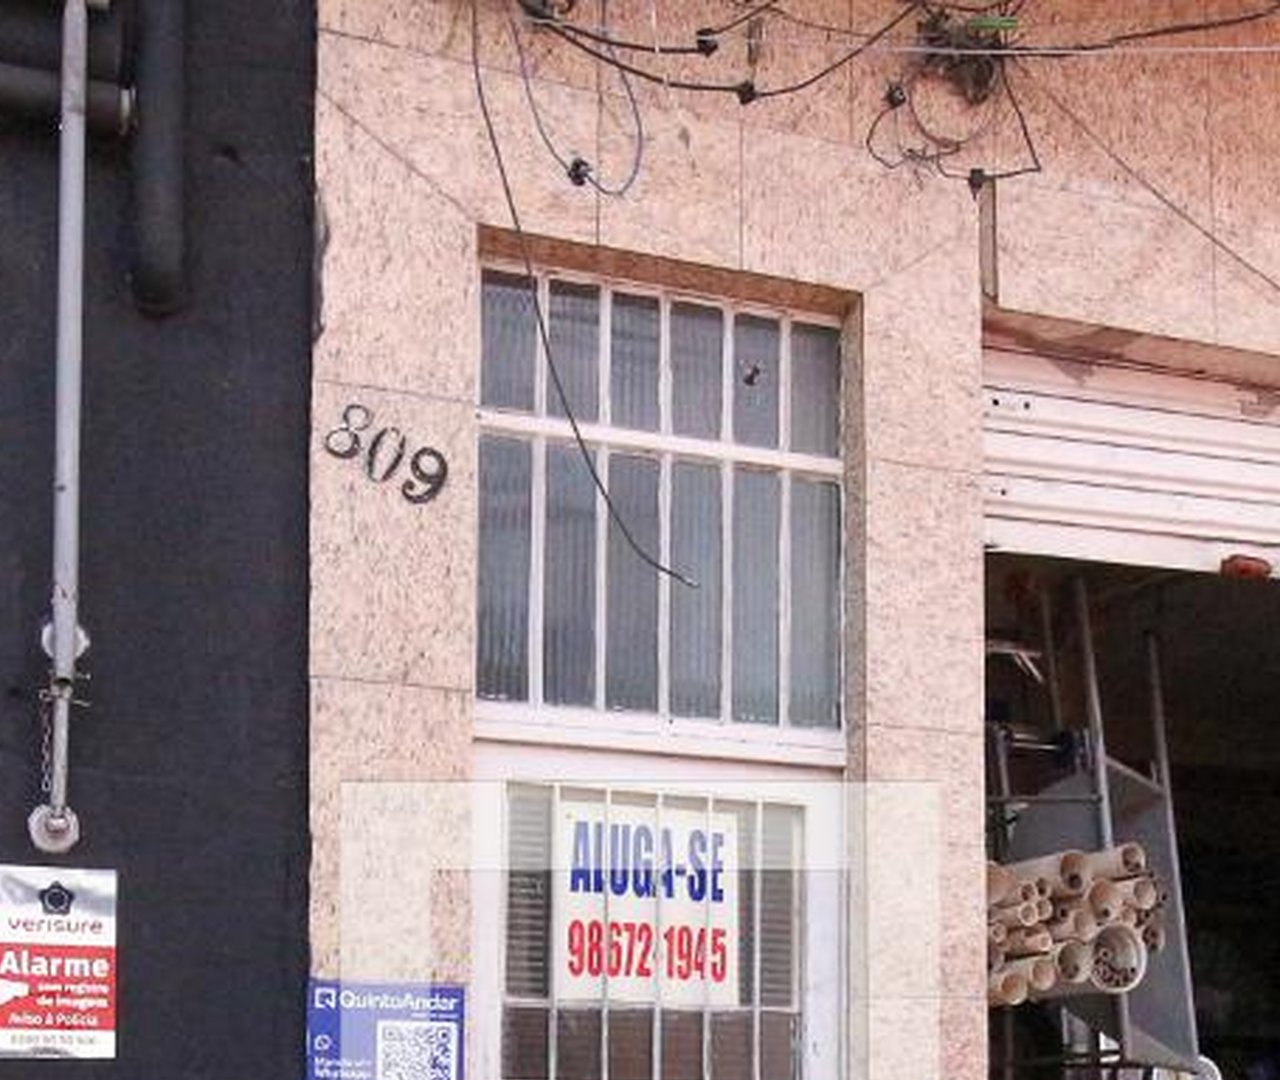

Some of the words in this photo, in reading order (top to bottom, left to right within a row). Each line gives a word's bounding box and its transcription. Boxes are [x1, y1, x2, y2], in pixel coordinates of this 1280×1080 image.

[324, 404, 448, 503] 809
[570, 821, 724, 903] ALUGA-SE
[8, 917, 104, 935] verisure
[0, 950, 110, 977] Alarme
